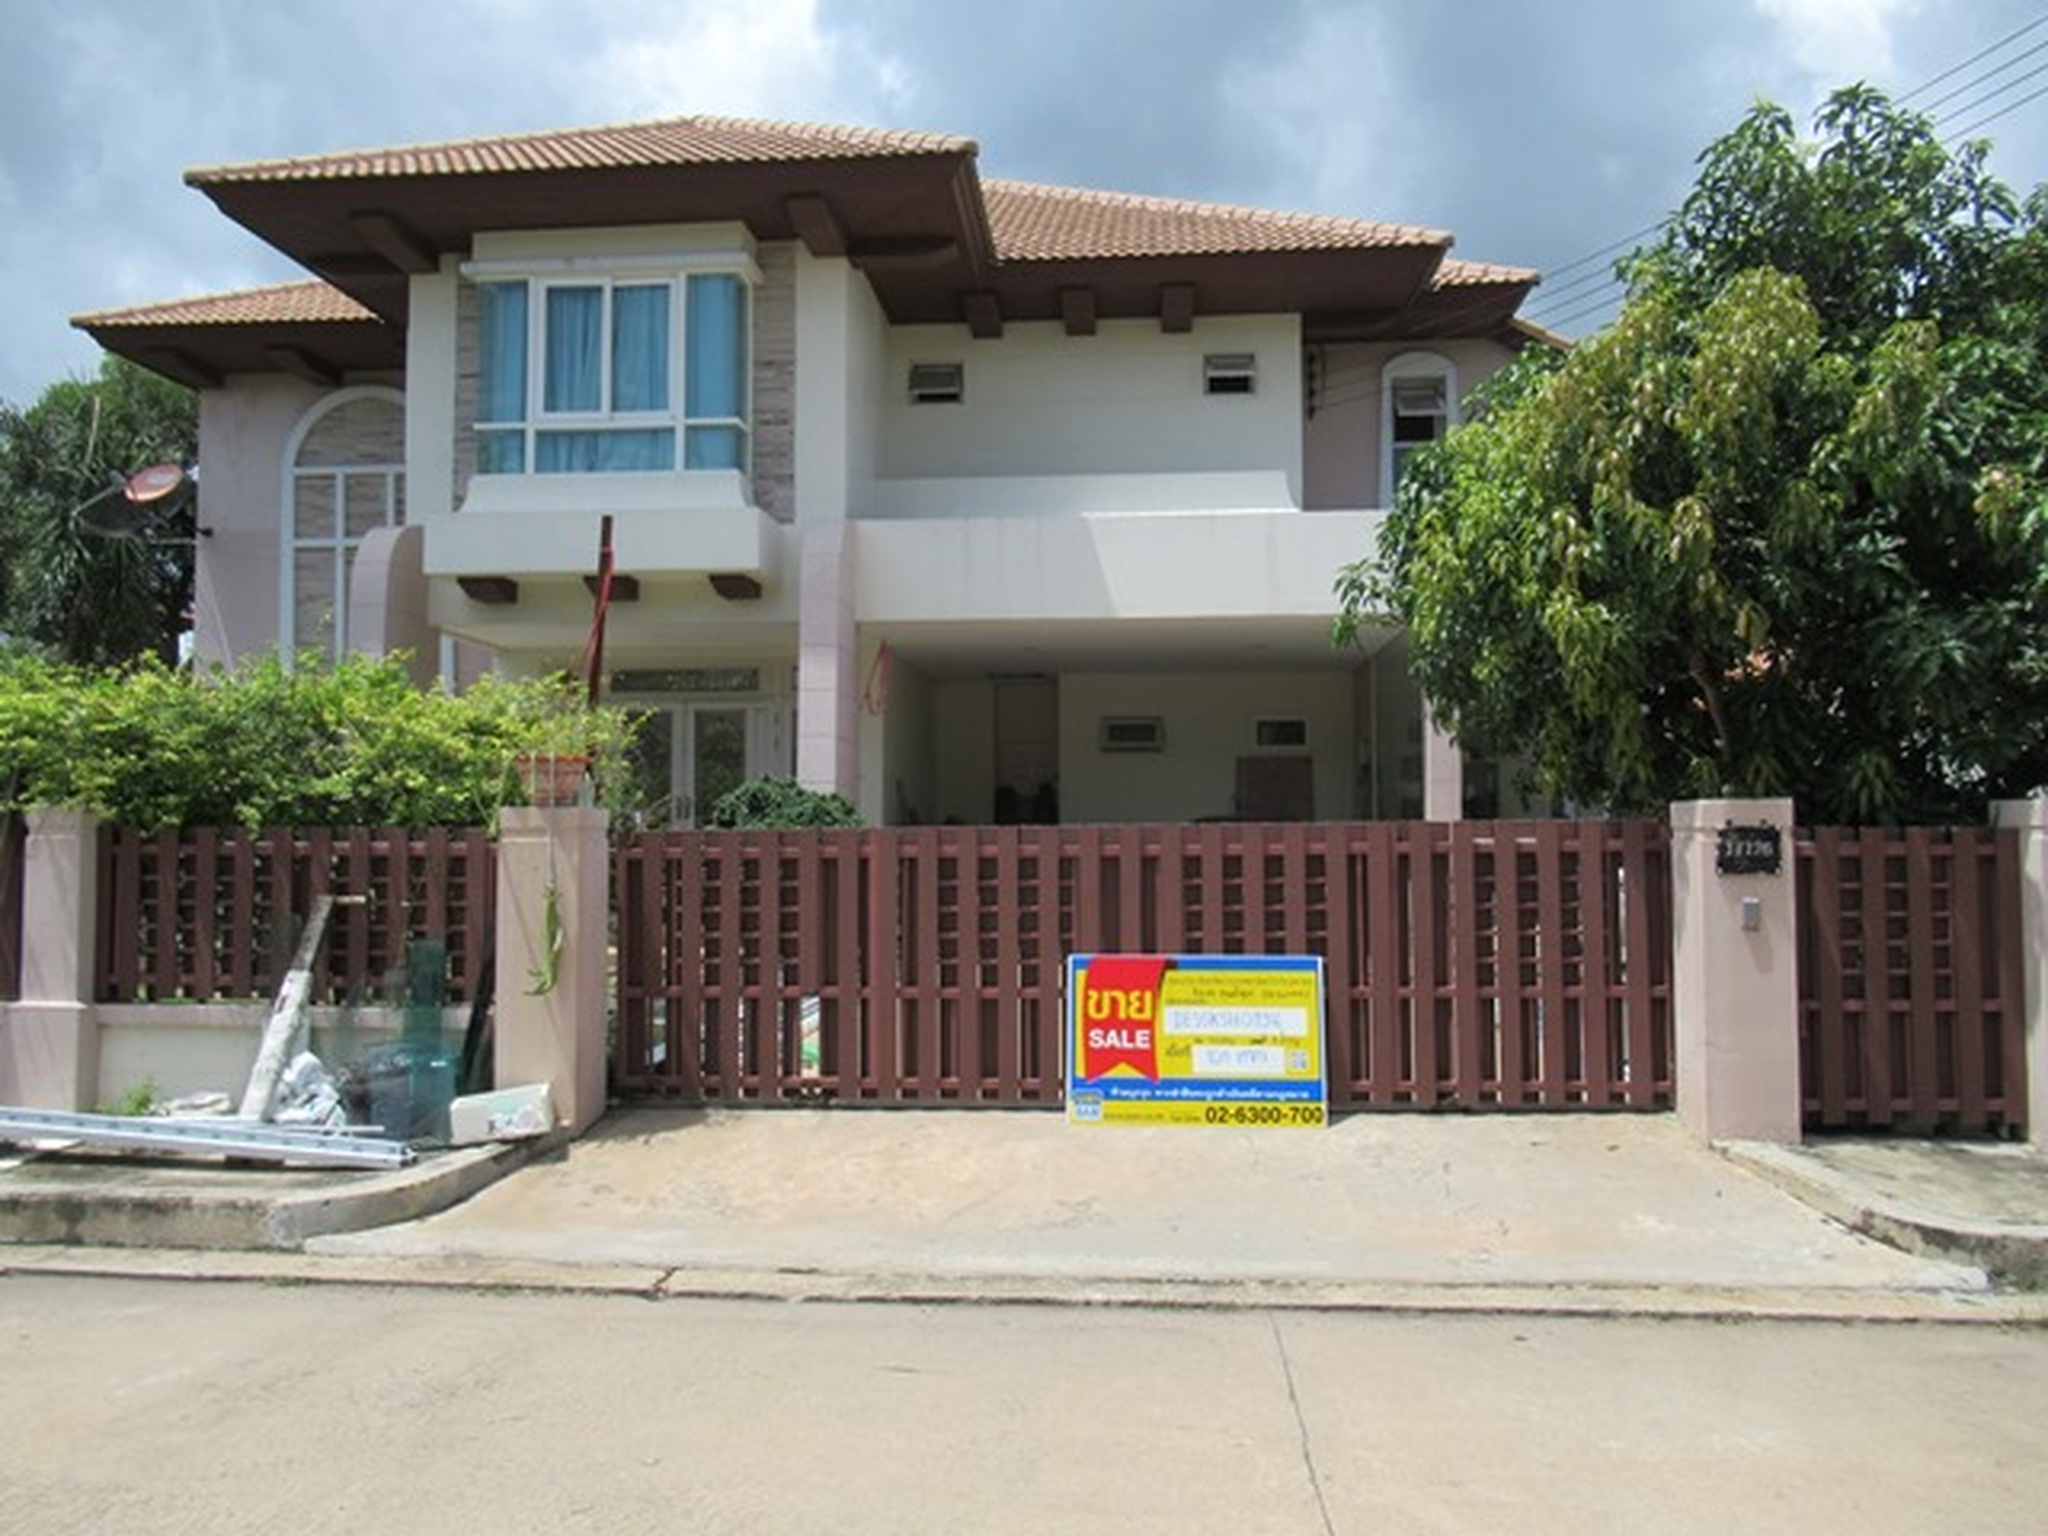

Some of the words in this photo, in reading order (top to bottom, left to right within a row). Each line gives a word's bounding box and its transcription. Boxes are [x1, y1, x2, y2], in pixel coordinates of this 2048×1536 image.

[1087, 989, 1152, 1020] ขาย
[1088, 1028, 1152, 1049] SALE
[1205, 1106, 1323, 1124] 02-6300-700
